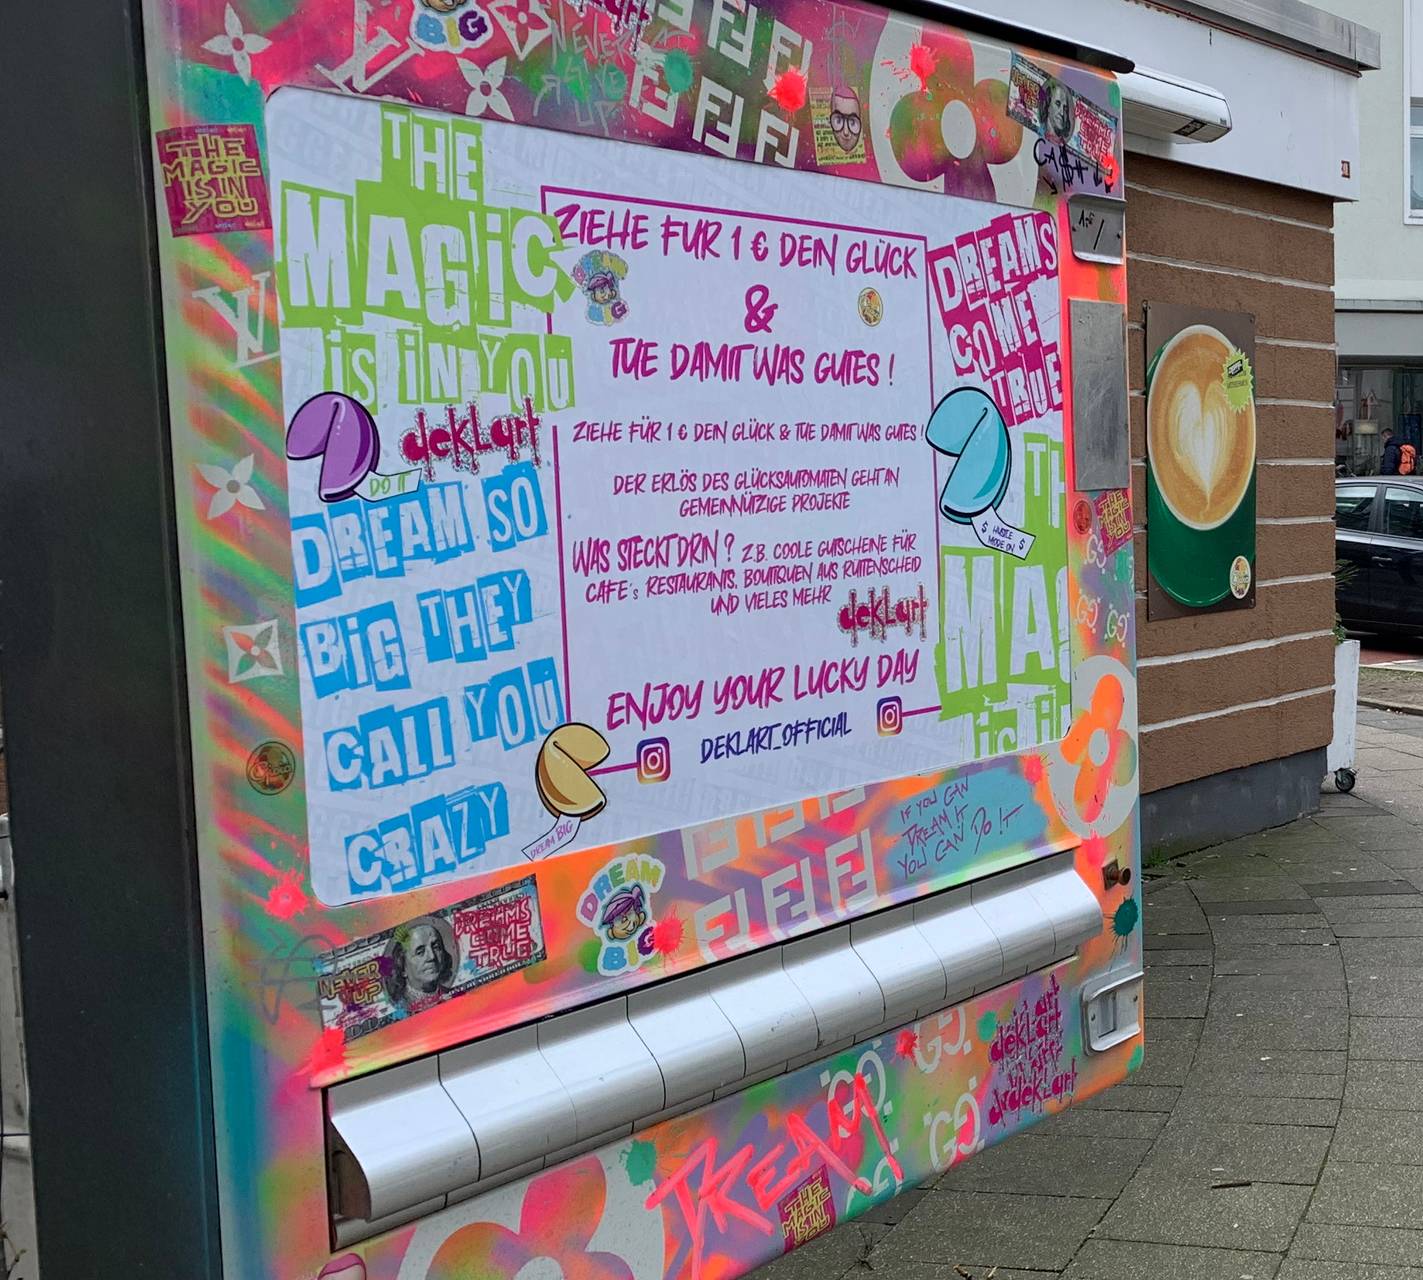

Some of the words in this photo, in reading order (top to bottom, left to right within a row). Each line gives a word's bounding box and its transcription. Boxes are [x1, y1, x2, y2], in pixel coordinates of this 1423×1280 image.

[416, 10, 488, 48] BIG
[166, 134, 245, 160] THE
[383, 111, 478, 201] THE
[162, 158, 260, 187] MAGIC
[182, 177, 216, 200] IS
[182, 197, 258, 224] YOU
[553, 204, 649, 250] ZIEHE
[731, 225, 742, 259] 1
[750, 230, 769, 262] €
[779, 232, 838, 275] DEIN
[845, 239, 918, 279] GLÜCK
[934, 215, 1057, 312] DREAMS
[744, 284, 778, 333] &
[949, 290, 1038, 377] COME
[609, 337, 658, 380] TUE
[669, 341, 754, 382] DAMIT
[752, 344, 804, 386] WAS
[813, 350, 880, 387] GUTES
[888, 353, 895, 386] !
[992, 353, 1062, 416] TRUE
[573, 420, 622, 443] ZIEHE
[628, 415, 662, 443] FÜR
[667, 422, 673, 441] 1
[678, 424, 688, 441] €
[693, 420, 728, 444] DEIN
[732, 418, 775, 442] GLÜCK
[779, 424, 791, 440] &
[795, 422, 816, 442] TUE
[820, 422, 858, 442] DAMIT
[856, 422, 881, 442] WAS
[885, 423, 917, 442] GUTES
[369, 477, 391, 497] DO
[613, 472, 647, 495] DER
[651, 469, 697, 494] ERLÖS
[702, 471, 730, 492] DES
[851, 468, 885, 487] GEHT
[884, 467, 900, 488] AN
[792, 491, 851, 513] PROJEKTE
[291, 485, 468, 590] DREAM
[488, 477, 538, 541] SO
[573, 537, 610, 577] WAS
[617, 533, 679, 572] STECKT
[677, 529, 719, 568] DRIN
[724, 532, 735, 562] ?
[773, 540, 813, 560] COOLE
[892, 528, 917, 552] FÜR
[817, 560, 838, 581] AUS
[422, 574, 522, 653] THEY
[711, 593, 739, 616] UND
[745, 590, 789, 613] VIELES
[793, 585, 832, 607] MEHR
[606, 680, 704, 731] ENJOY
[713, 666, 785, 715] YOUR
[793, 656, 870, 700] LUCKY
[877, 648, 920, 689] DAY
[327, 707, 451, 784] CALL
[467, 672, 559, 745] YOU
[699, 711, 852, 764] DEKLART_OFFICIAL
[916, 789, 937, 816] YOU
[943, 775, 968, 806] CAN
[348, 787, 499, 886] CRAZY
[897, 846, 927, 879] YOU
[935, 821, 964, 861] CAN
[581, 859, 661, 921] DREAM
